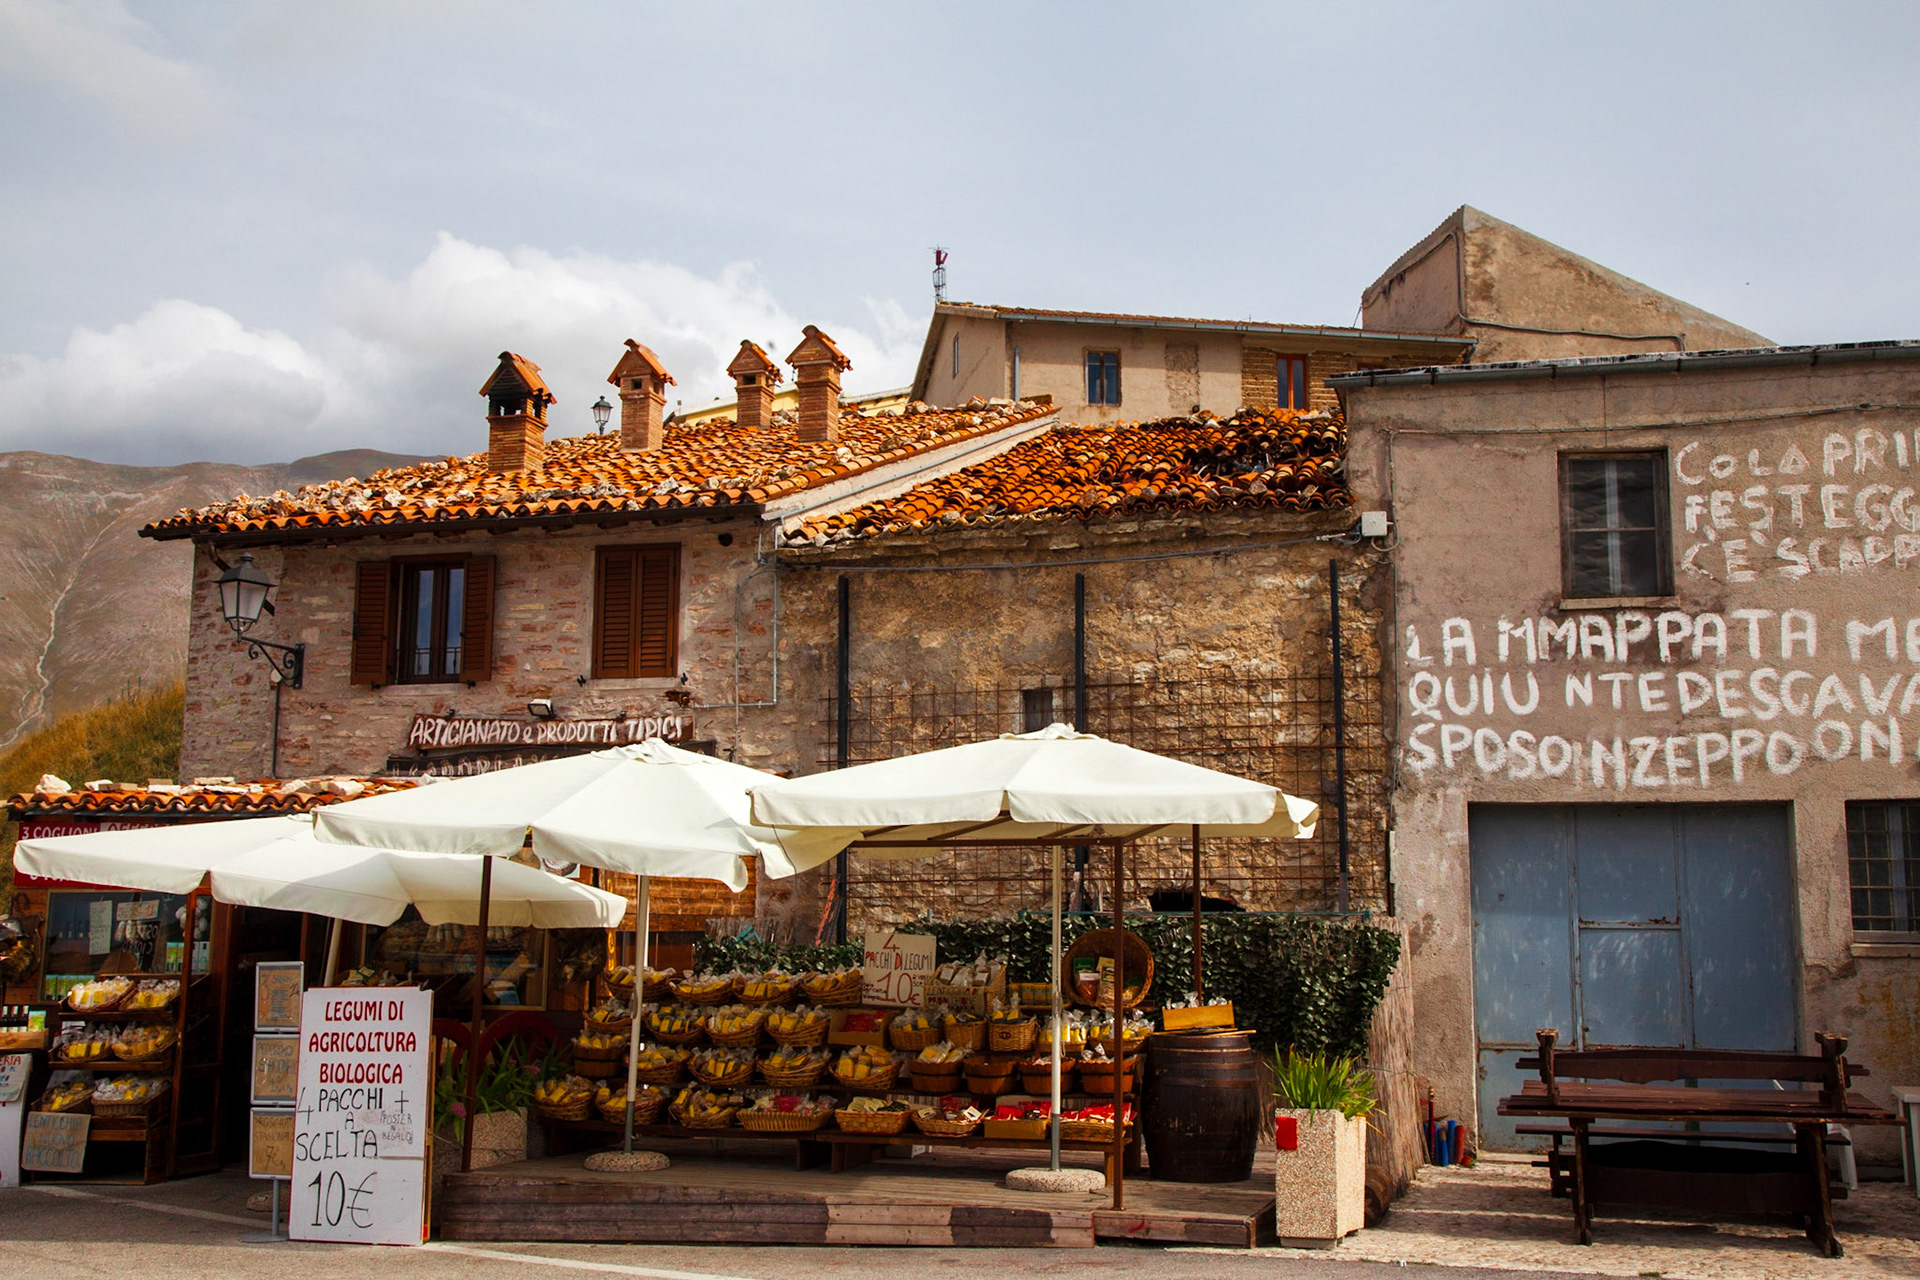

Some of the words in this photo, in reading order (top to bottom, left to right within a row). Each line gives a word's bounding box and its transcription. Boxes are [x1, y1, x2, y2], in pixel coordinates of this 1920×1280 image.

[410, 717, 520, 746] ARTIGIANATO
[536, 719, 617, 744] PRODOTTI
[882, 932, 900, 952] 4
[324, 1001, 382, 1022] LEGUMI
[388, 1001, 404, 1021] DI
[308, 1031, 417, 1053] AGRICOLTURA
[319, 1063, 403, 1084] BIOLOGICA
[297, 1087, 315, 1125] 4
[318, 1087, 383, 1112] PACCHI
[344, 1111, 355, 1130] A
[296, 1129, 379, 1162] SCELTA
[308, 1170, 377, 1229] 10€
